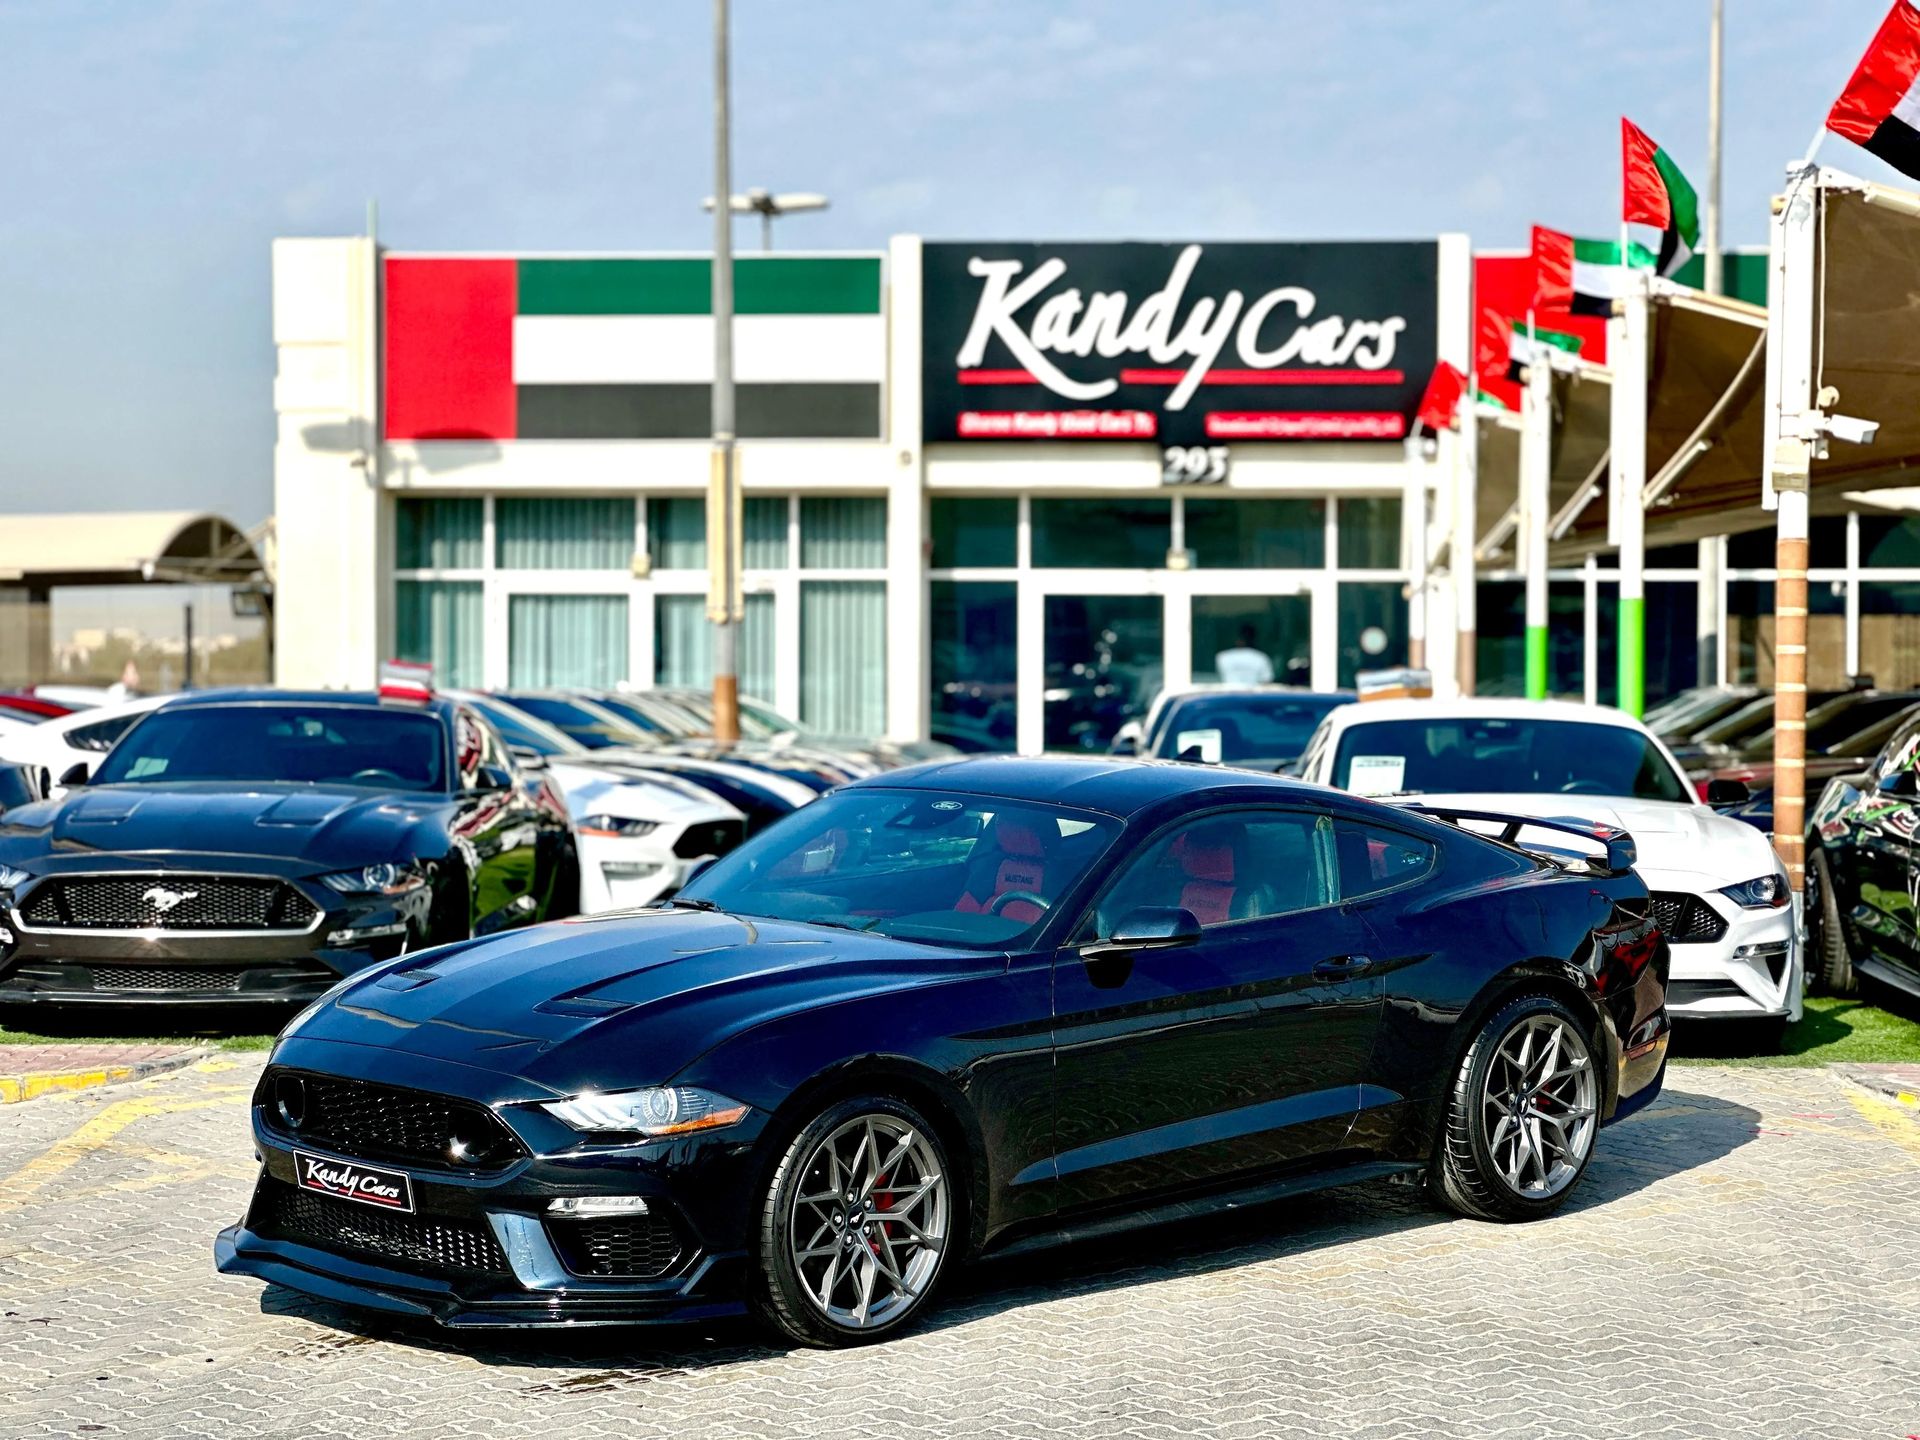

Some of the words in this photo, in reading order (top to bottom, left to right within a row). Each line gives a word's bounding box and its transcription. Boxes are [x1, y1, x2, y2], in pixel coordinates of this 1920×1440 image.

[957, 244, 1244, 410] Kandy
[1236, 286, 1406, 369] Cars
[305, 1158, 359, 1196] Kandy
[359, 1176, 400, 1197] Cars
